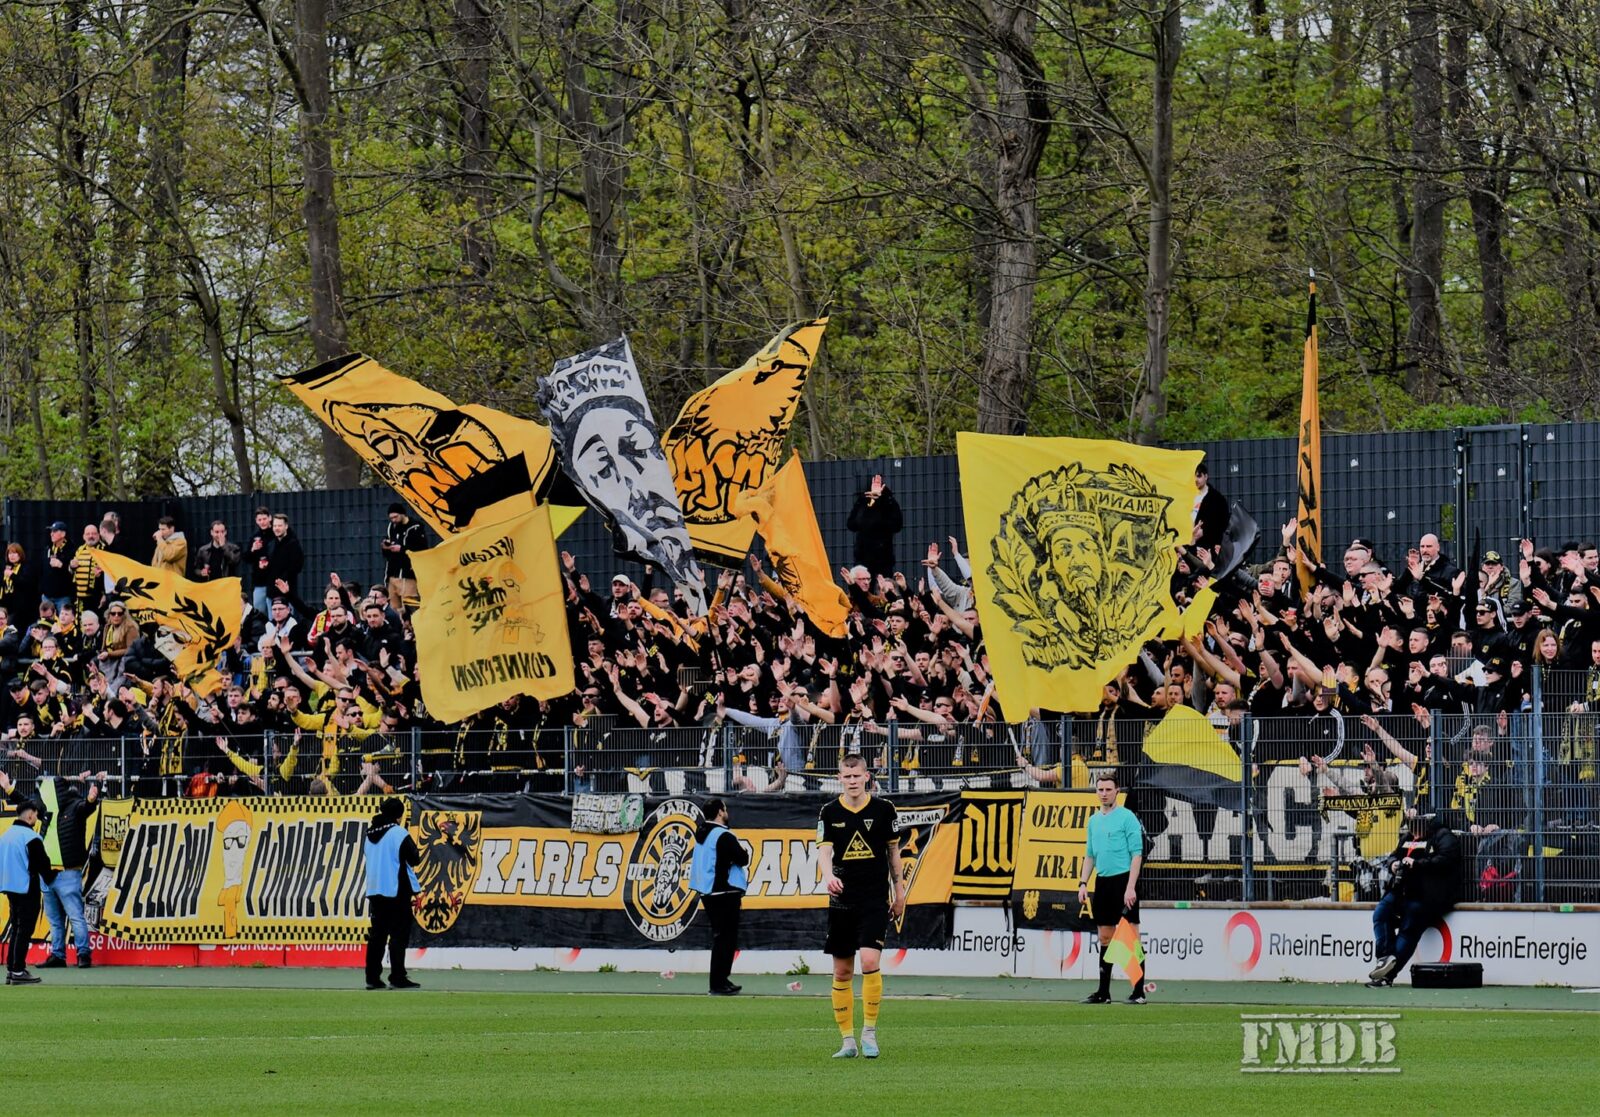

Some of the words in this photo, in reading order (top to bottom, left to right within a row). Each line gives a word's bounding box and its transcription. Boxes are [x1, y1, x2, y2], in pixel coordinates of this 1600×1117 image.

[656, 801, 699, 822] KARLS
[114, 820, 215, 918] YELLOW
[472, 838, 624, 896] KARLS
[638, 918, 685, 939] BANDE
[1269, 933, 1373, 963] RheinEnerg
[1459, 935, 1588, 965] RheinEnergie
